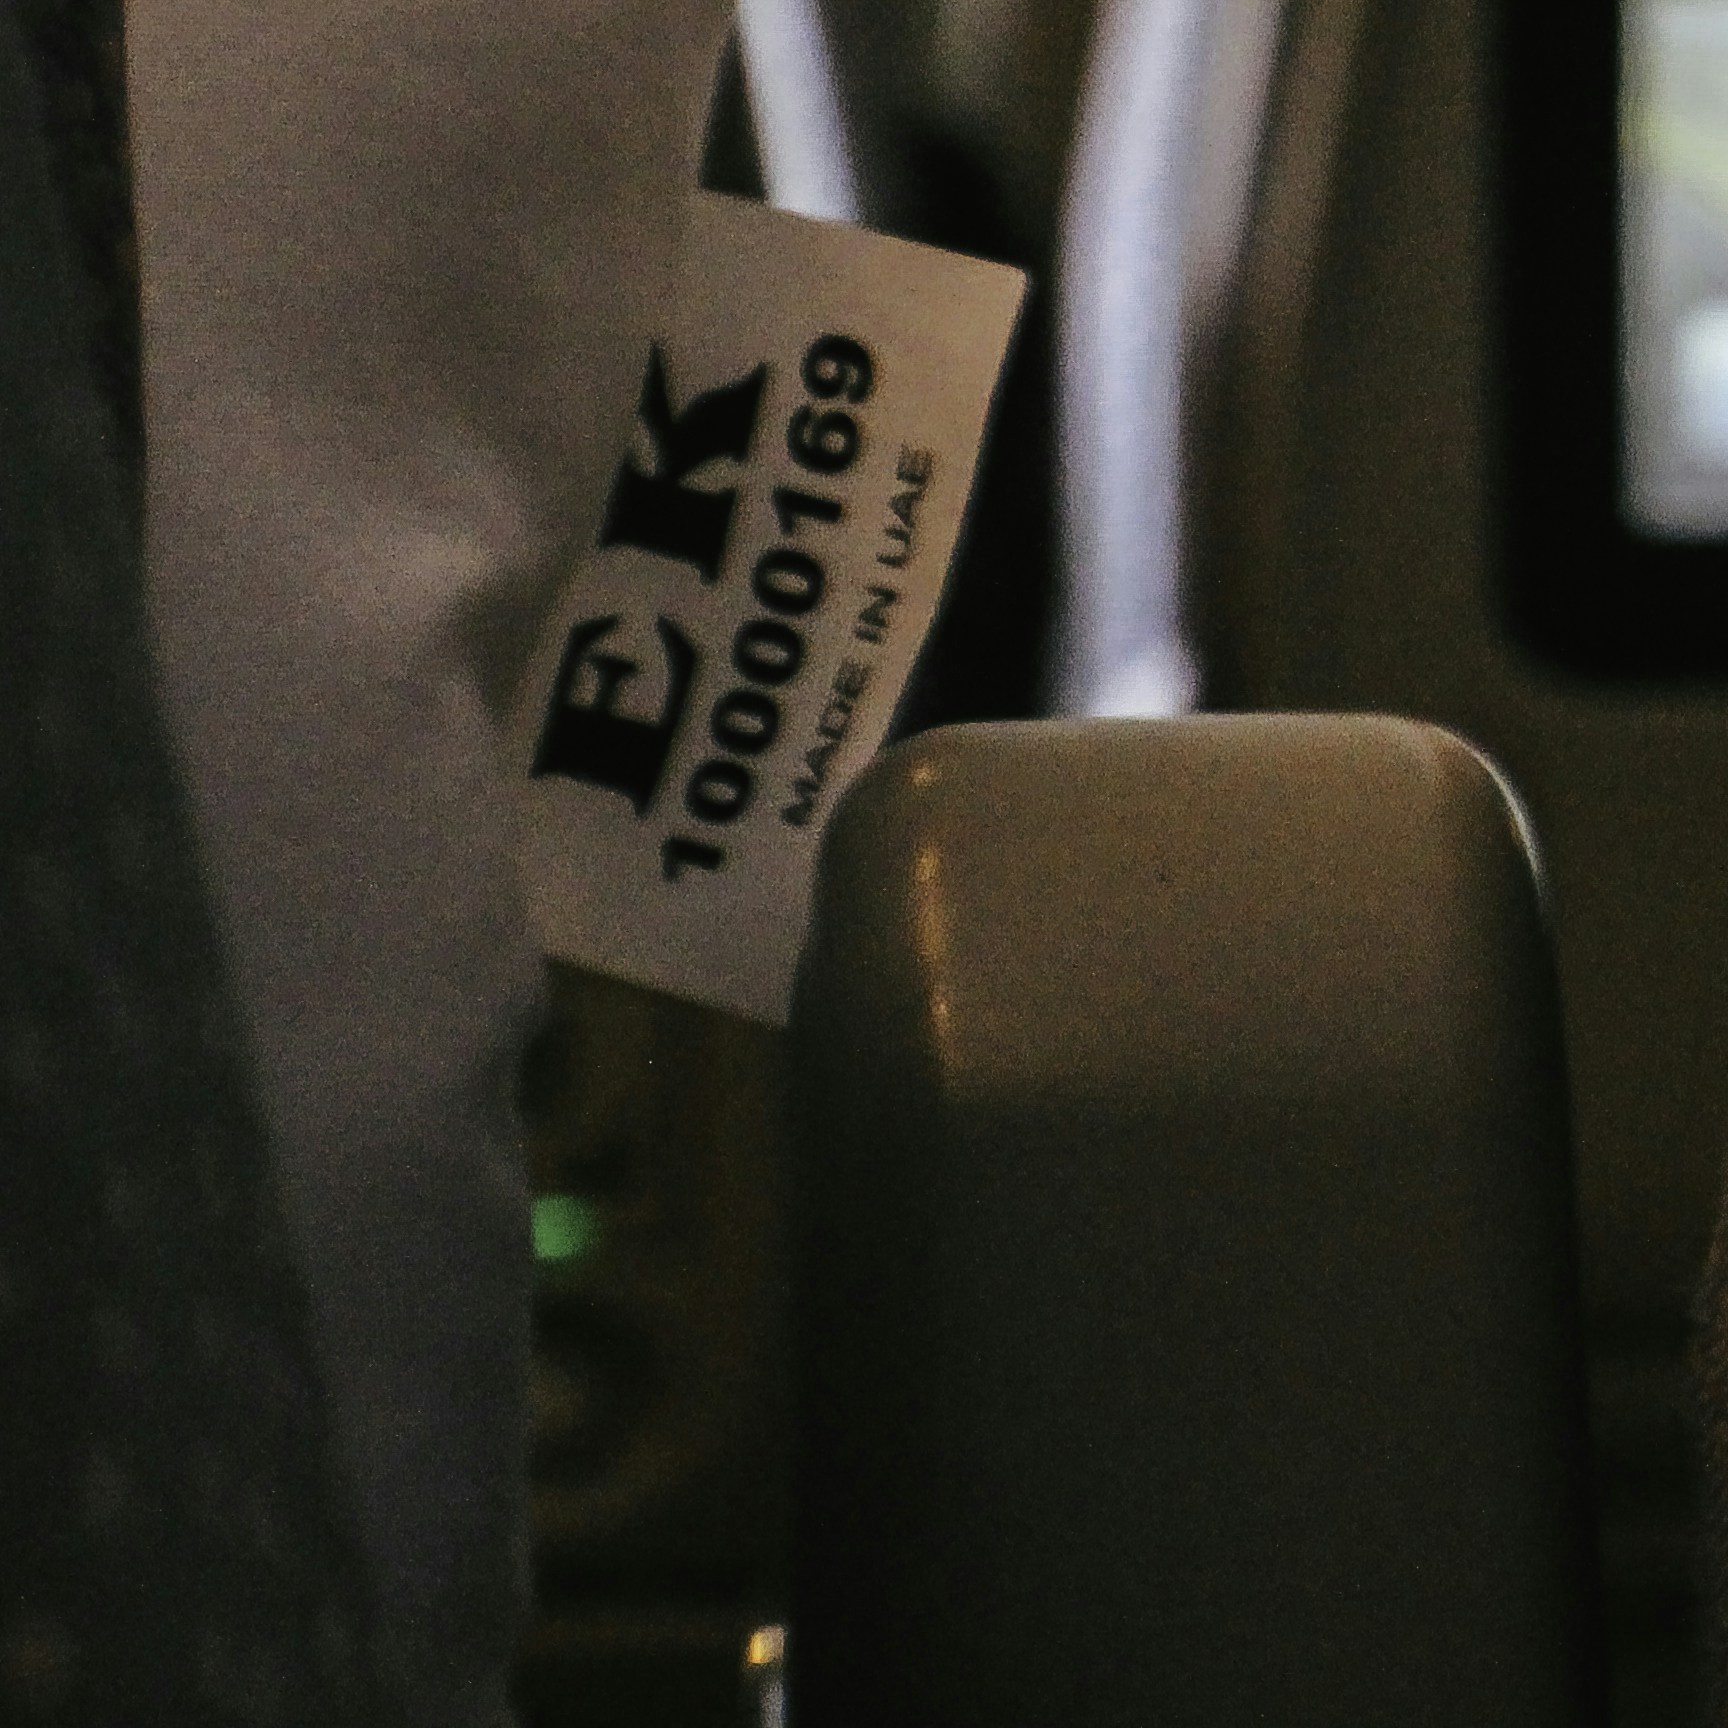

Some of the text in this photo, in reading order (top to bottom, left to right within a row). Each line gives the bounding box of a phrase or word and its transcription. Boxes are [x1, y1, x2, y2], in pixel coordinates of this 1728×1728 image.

[532, 337, 775, 817] EK
[660, 332, 878, 884] 10000169
[780, 444, 938, 828] MADE IN UAE
